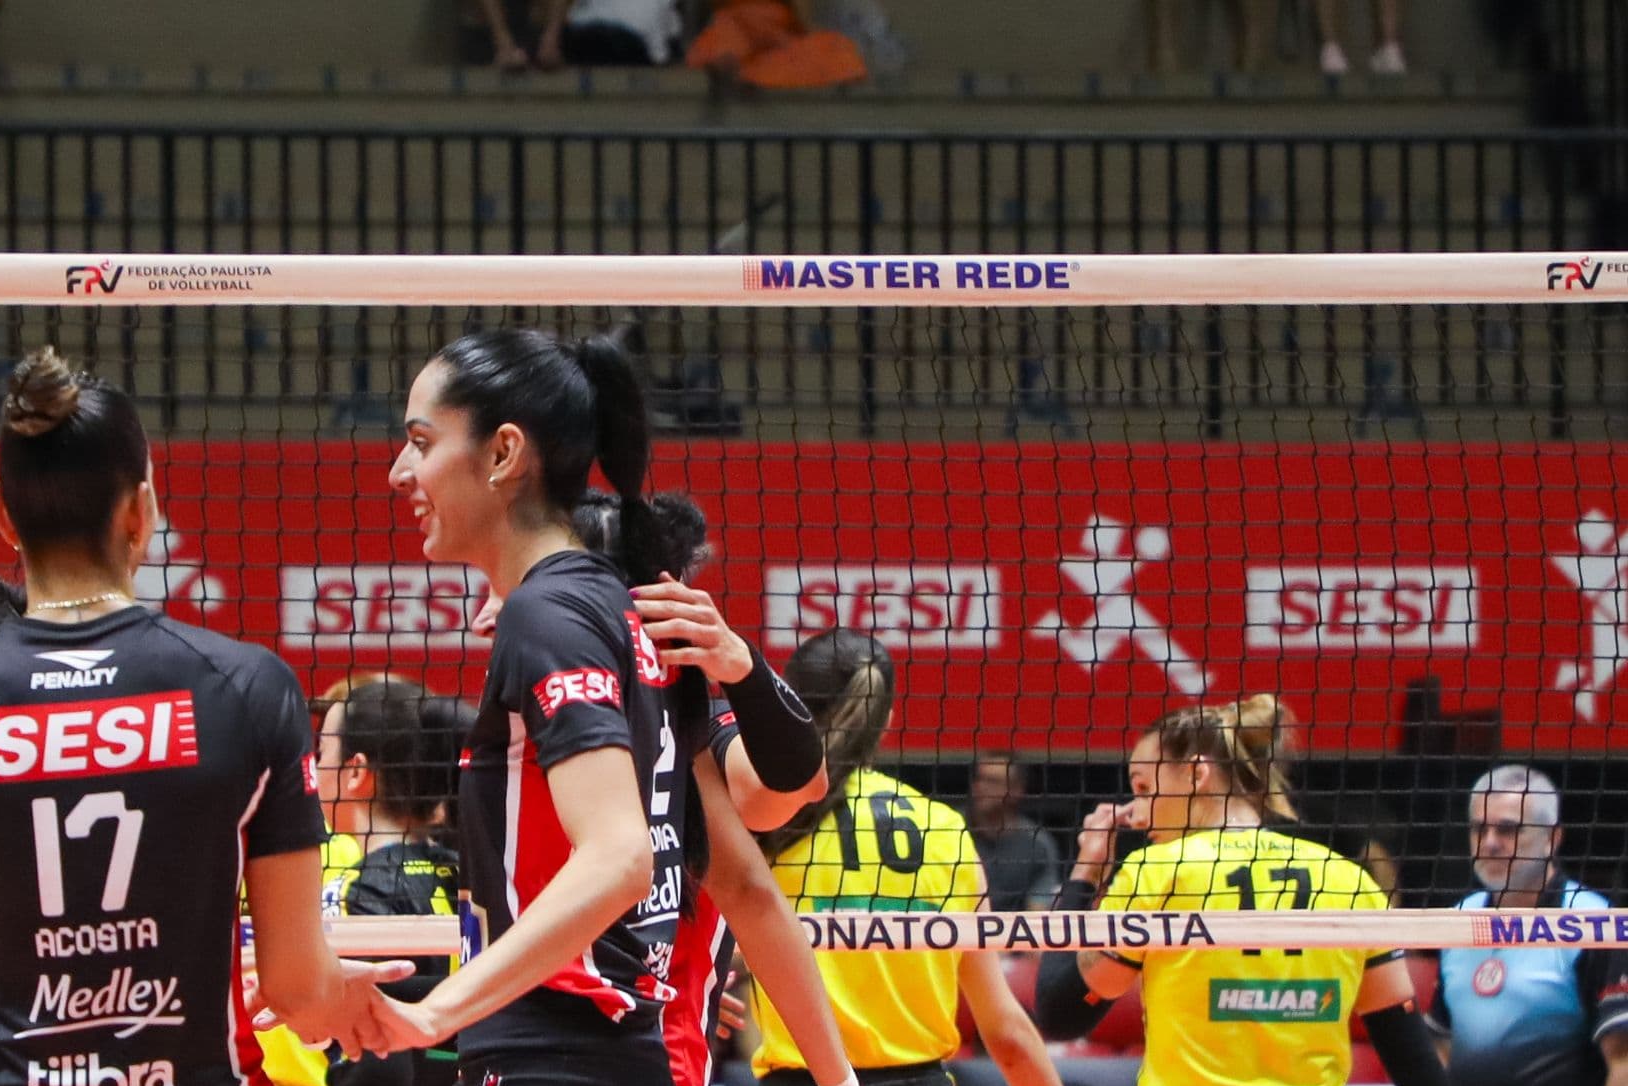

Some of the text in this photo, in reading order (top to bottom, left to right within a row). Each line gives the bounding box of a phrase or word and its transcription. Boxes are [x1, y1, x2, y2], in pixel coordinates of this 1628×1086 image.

[128, 264, 207, 278] FEDERAÇÃO
[211, 265, 272, 277] PAULISTA
[148, 280, 253, 291] DE VOLLEYBALL
[761, 260, 1070, 289] MASTER REDE
[790, 579, 974, 637] SESI
[1269, 579, 1454, 636] SESI
[30, 667, 118, 690] PENALTY
[833, 790, 923, 874] 16
[31, 791, 145, 918] 17
[35, 917, 159, 958] ACOSTA
[977, 912, 1215, 949] PAULISTA
[1490, 914, 1628, 943] MASTE
[1218, 989, 1317, 1010] HELIAR
